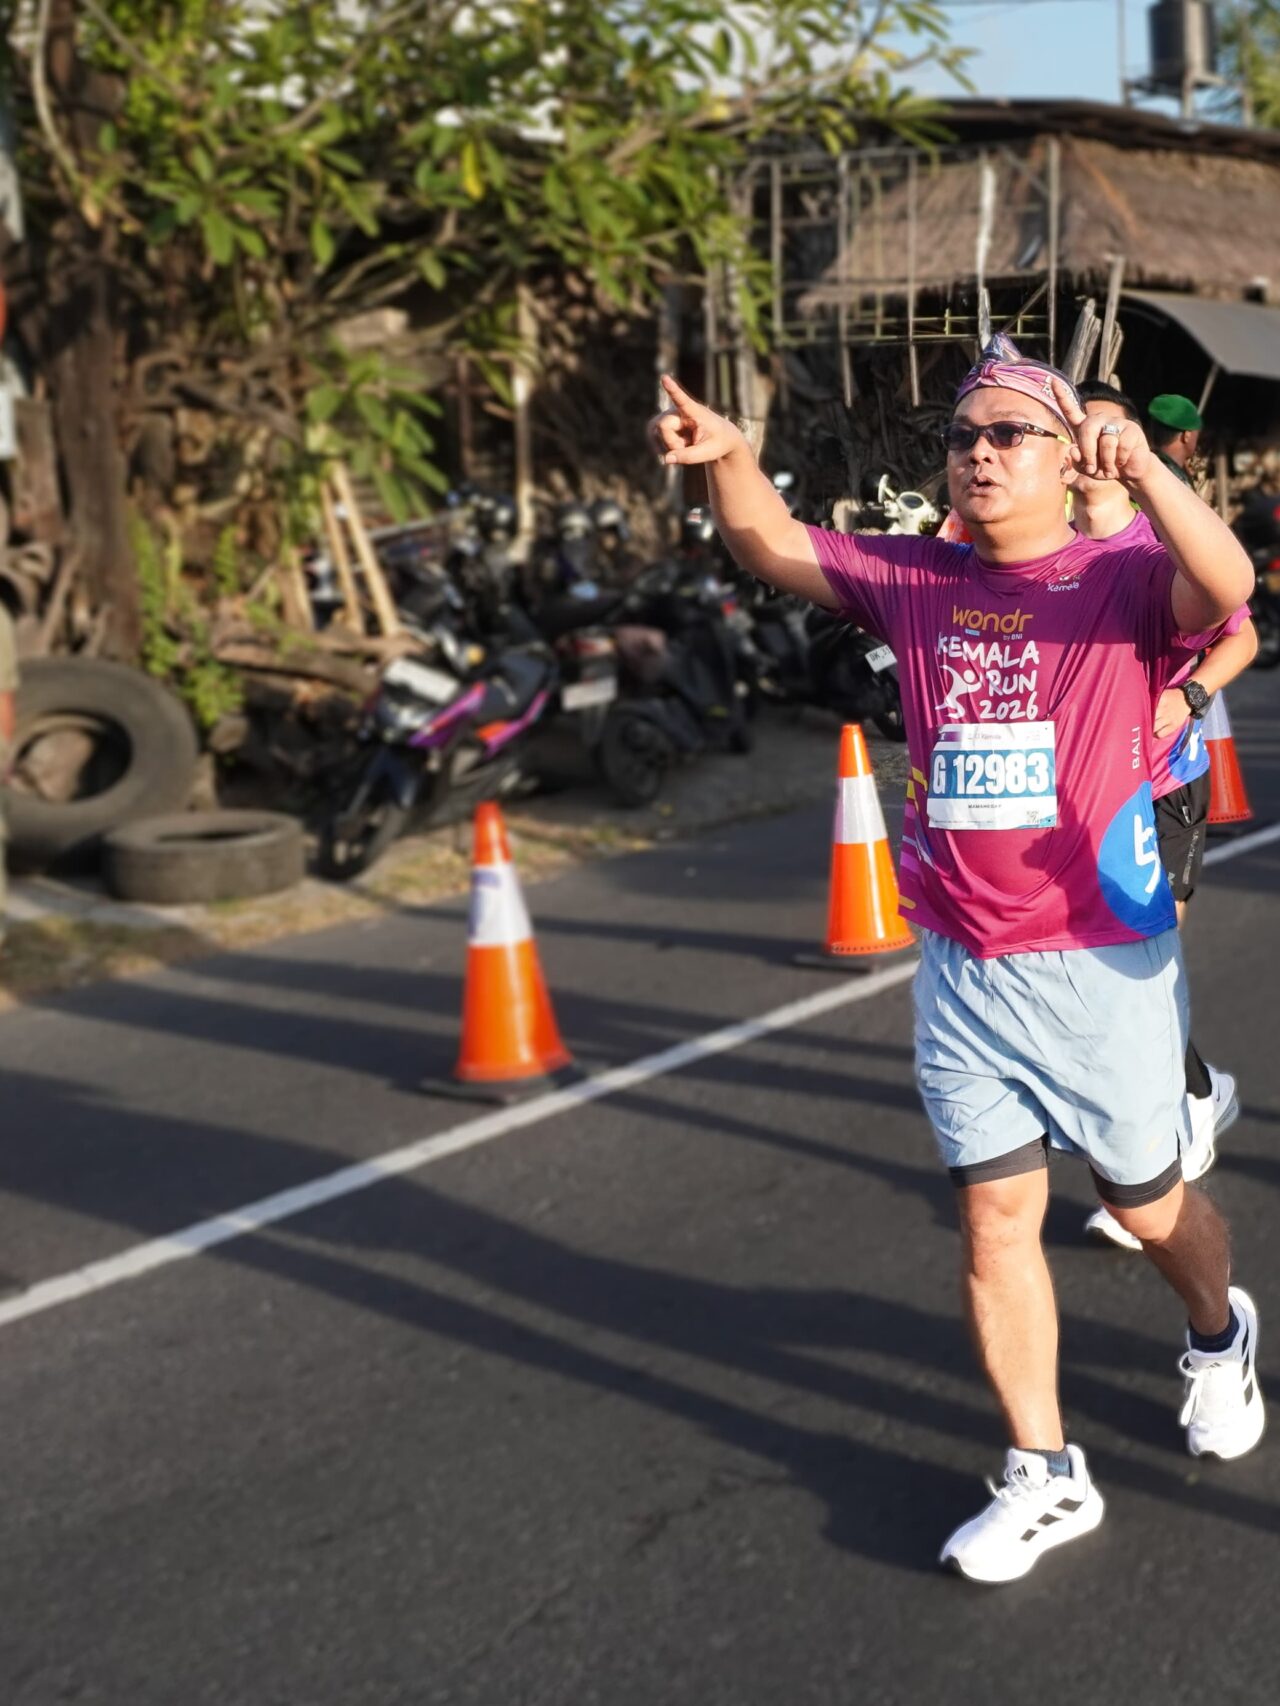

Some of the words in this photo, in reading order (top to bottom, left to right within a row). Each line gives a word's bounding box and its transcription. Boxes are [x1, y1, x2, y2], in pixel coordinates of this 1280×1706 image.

[1047, 581, 1080, 592] Kemala
[953, 605, 1034, 633] wondr
[937, 632, 1040, 669] KEMALA
[986, 669, 1038, 697] RUN
[979, 691, 1039, 720] 2026
[1131, 726, 1141, 770] BALI
[932, 754, 946, 794] G
[952, 752, 1050, 795] 12983
